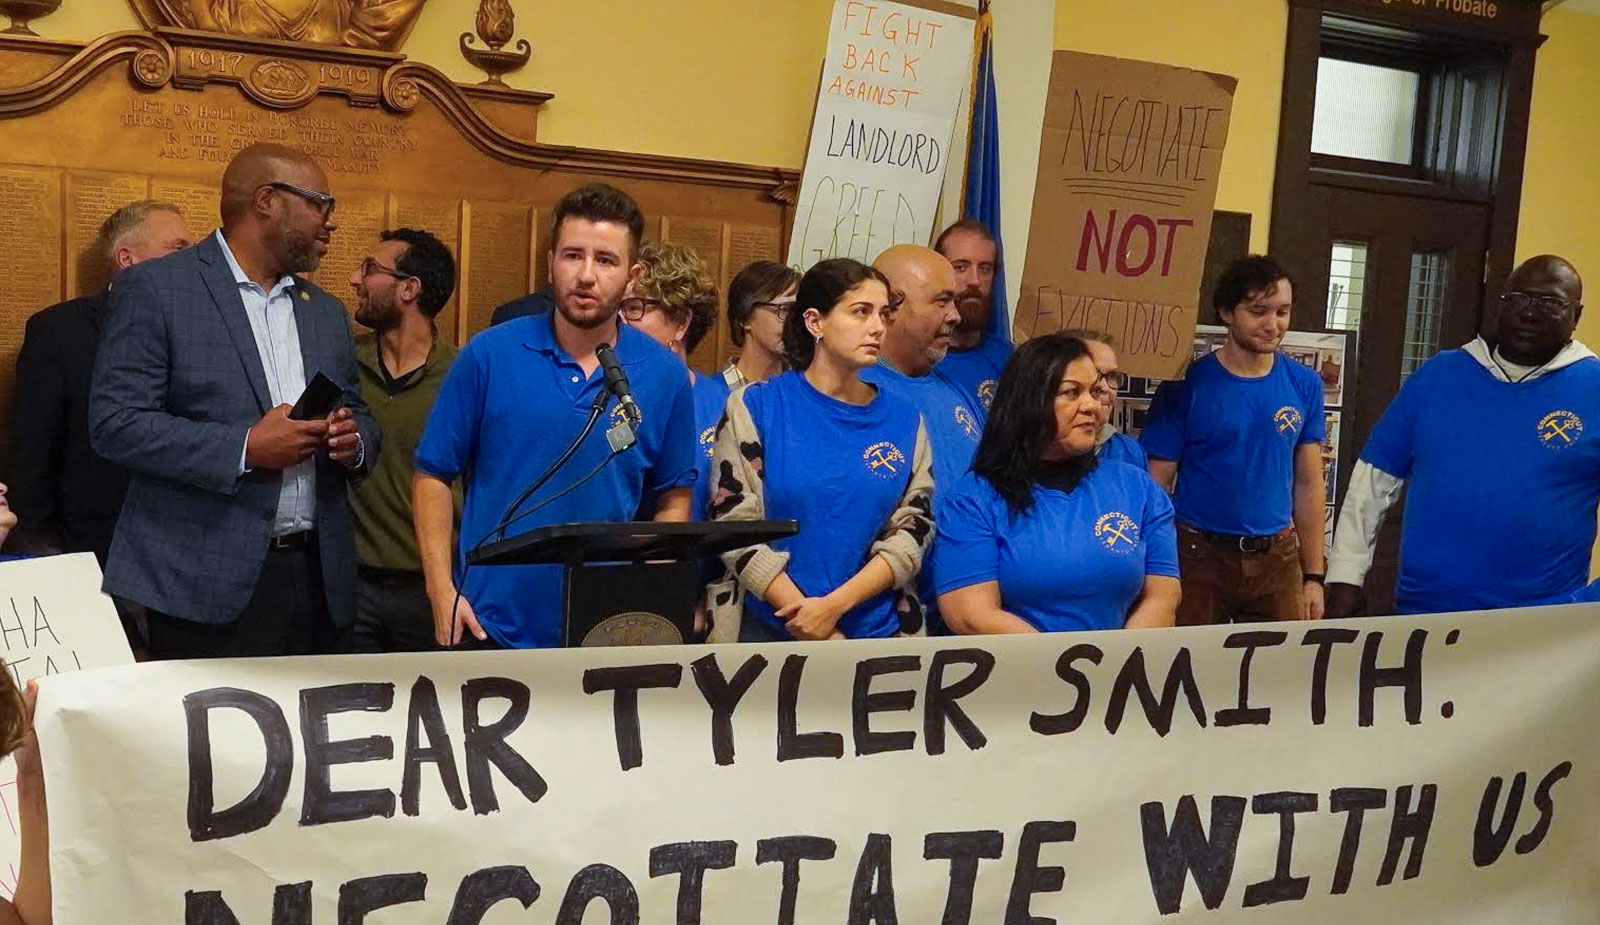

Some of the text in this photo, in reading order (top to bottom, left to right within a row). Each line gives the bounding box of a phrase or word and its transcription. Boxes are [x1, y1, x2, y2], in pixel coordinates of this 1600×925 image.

[844, 1, 943, 48] FIGHT
[187, 51, 245, 78] 1917
[319, 65, 370, 88] 1919
[843, 43, 919, 81] BACK
[131, 100, 164, 113] LET
[199, 105, 239, 120] HOLD
[828, 76, 920, 108] AGAINST
[120, 113, 174, 130] THOSE
[183, 119, 218, 134] WHO
[1062, 88, 1223, 182] NEGOTIATE
[302, 143, 342, 159] ORLD
[827, 115, 941, 175] LANDLORD
[800, 175, 915, 273] GREED
[1075, 209, 1194, 278] NOT
[183, 627, 1461, 842] DEAR TYLER SMITH:
[184, 760, 1572, 925] TIATE WITH US
